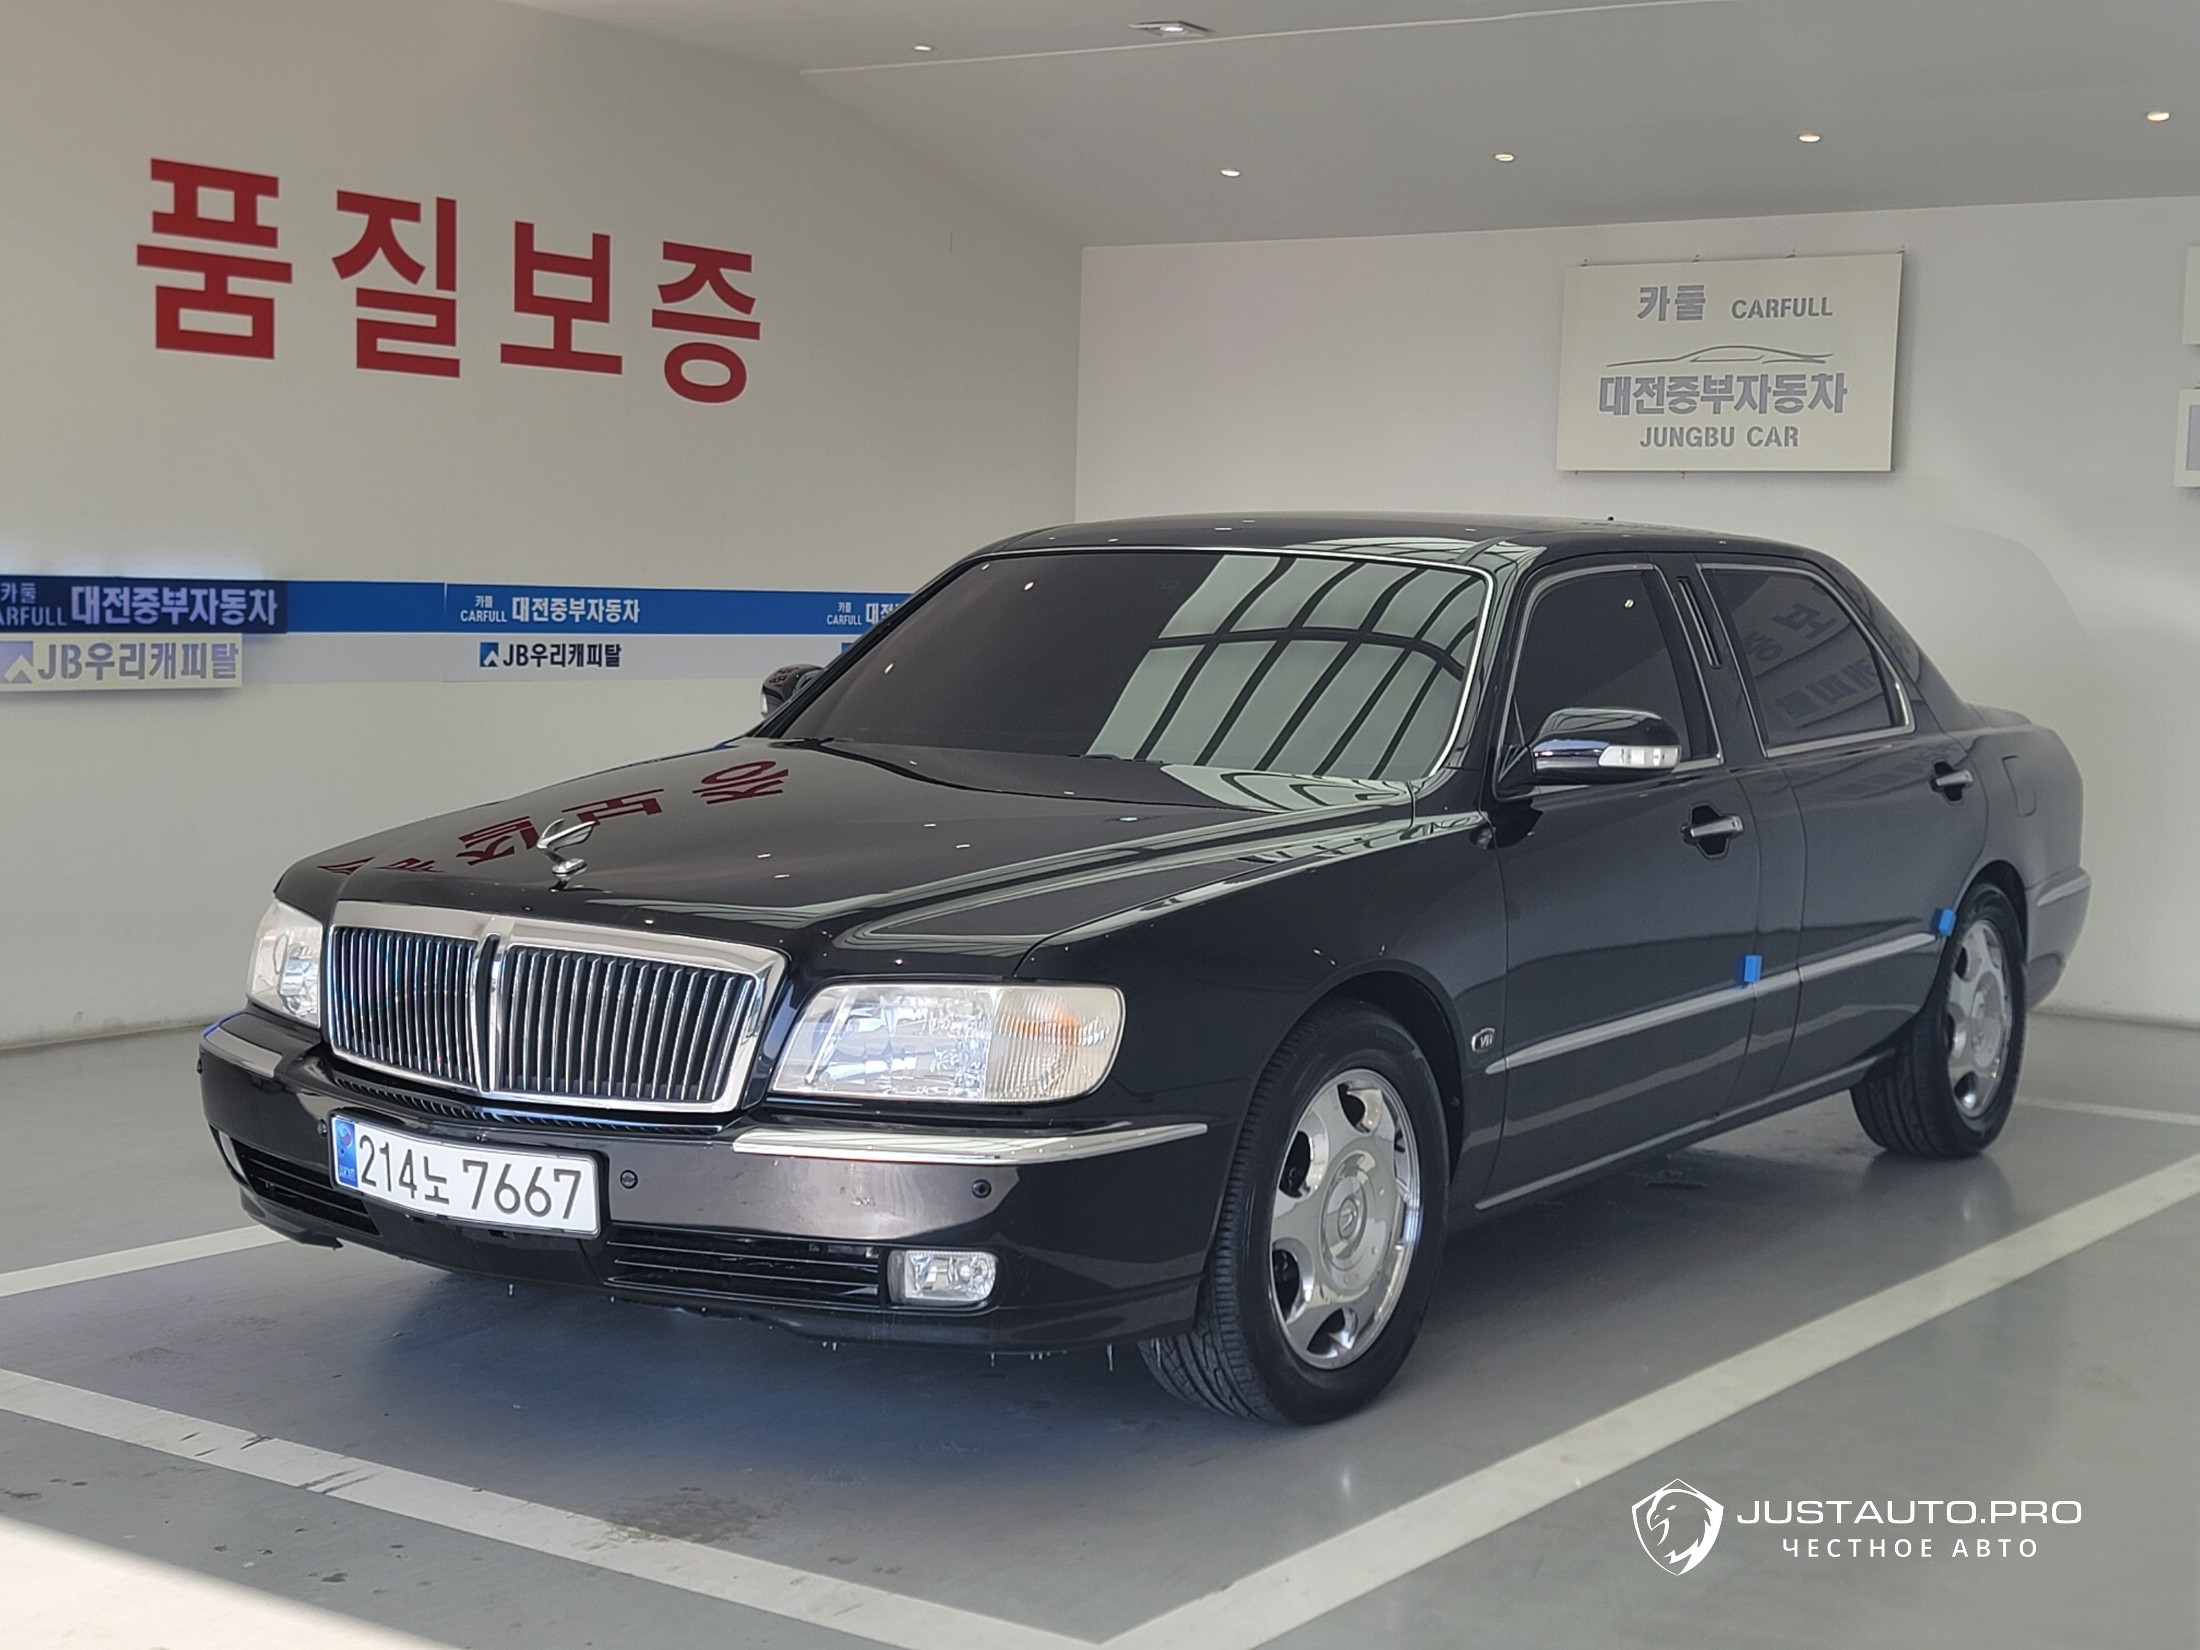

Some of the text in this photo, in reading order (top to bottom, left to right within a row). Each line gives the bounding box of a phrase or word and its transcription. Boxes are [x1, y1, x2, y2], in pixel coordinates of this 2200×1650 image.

[136, 157, 761, 404] 품질보증
[1731, 297, 1833, 319] CARFULL
[1599, 373, 1848, 416] 대전중부자동차
[1640, 426, 1799, 448] JUNGBU CAR
[71, 586, 278, 626] 대전중부자동차
[460, 609, 507, 623] CARFULL
[512, 597, 640, 623] 대전중부자동차
[826, 614, 862, 625] CARFULL
[38, 642, 239, 681] JB우리캐피탈
[503, 643, 622, 668] JB우리캐피탈
[359, 1134, 582, 1220] 214노 7667
